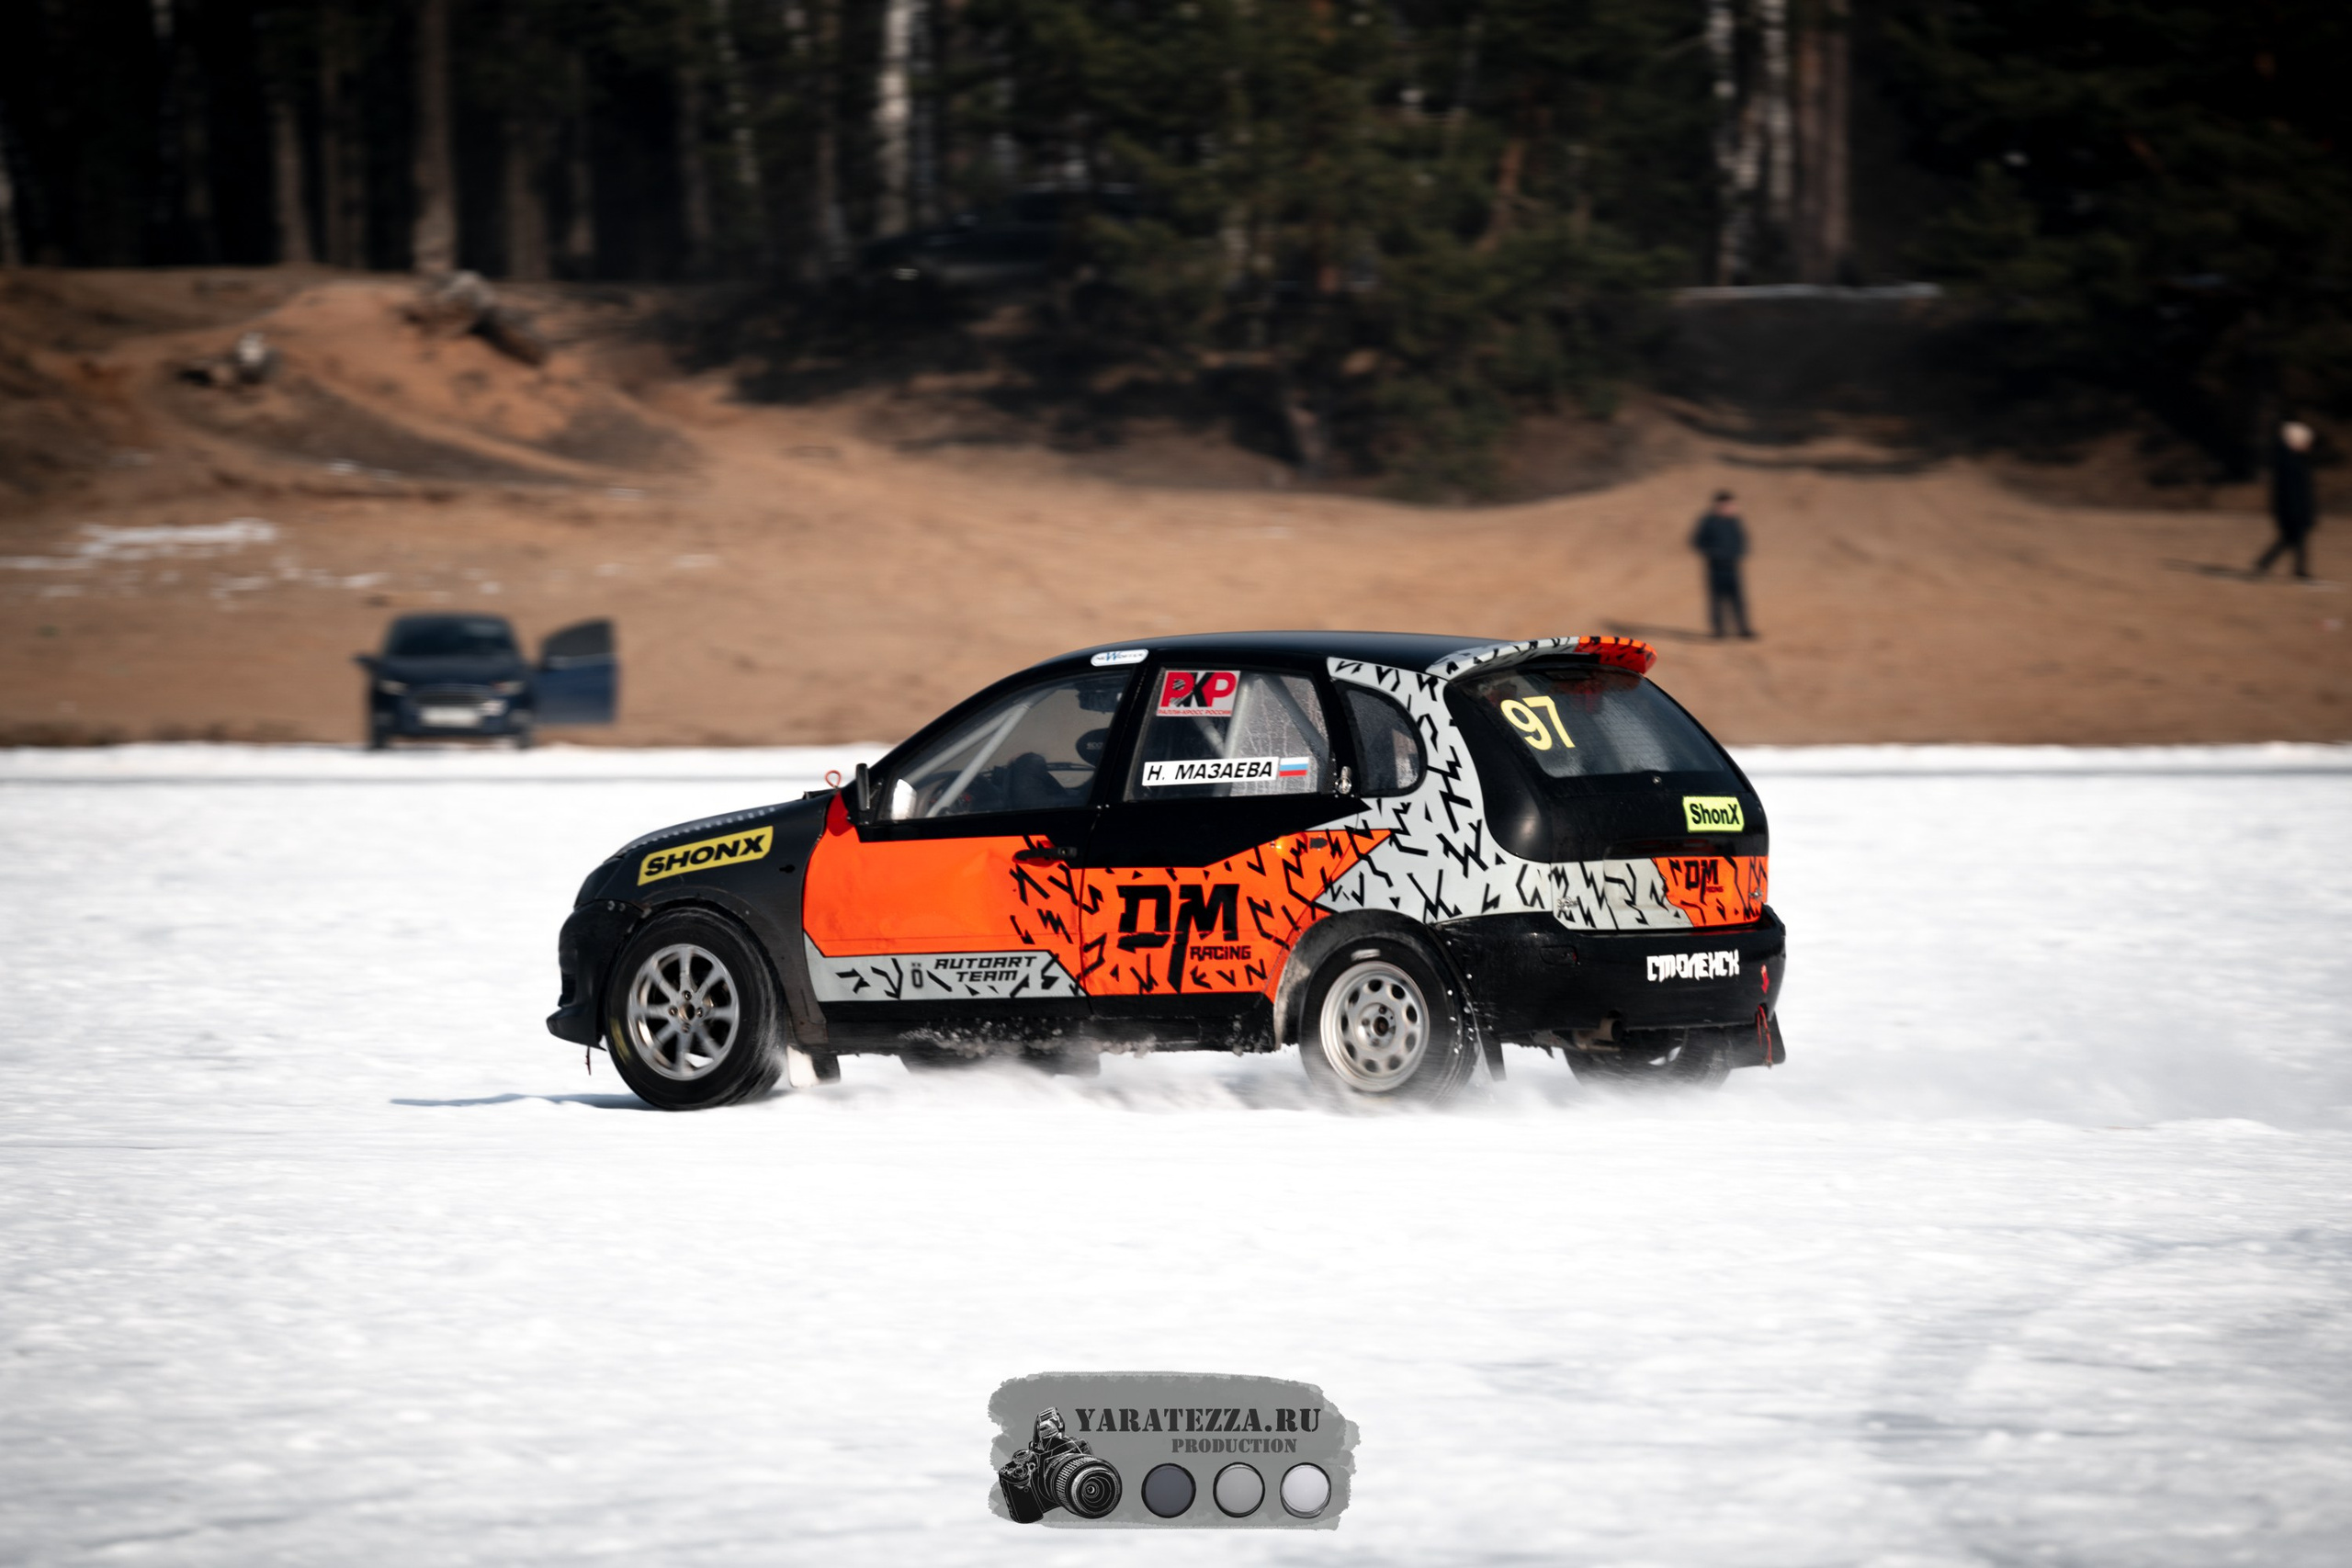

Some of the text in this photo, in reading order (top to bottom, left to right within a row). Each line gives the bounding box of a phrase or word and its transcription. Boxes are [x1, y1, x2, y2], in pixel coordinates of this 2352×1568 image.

[1500, 695, 1576, 750] 97
[1148, 761, 1272, 781] Н. МАЗАЕВА
[1690, 803, 1740, 825] ShonX
[644, 834, 765, 876] SHONX
[1683, 859, 1719, 905] DM
[1116, 883, 1240, 994] DM
[933, 955, 1038, 970] AUTOART
[956, 970, 1018, 982] TEAM
